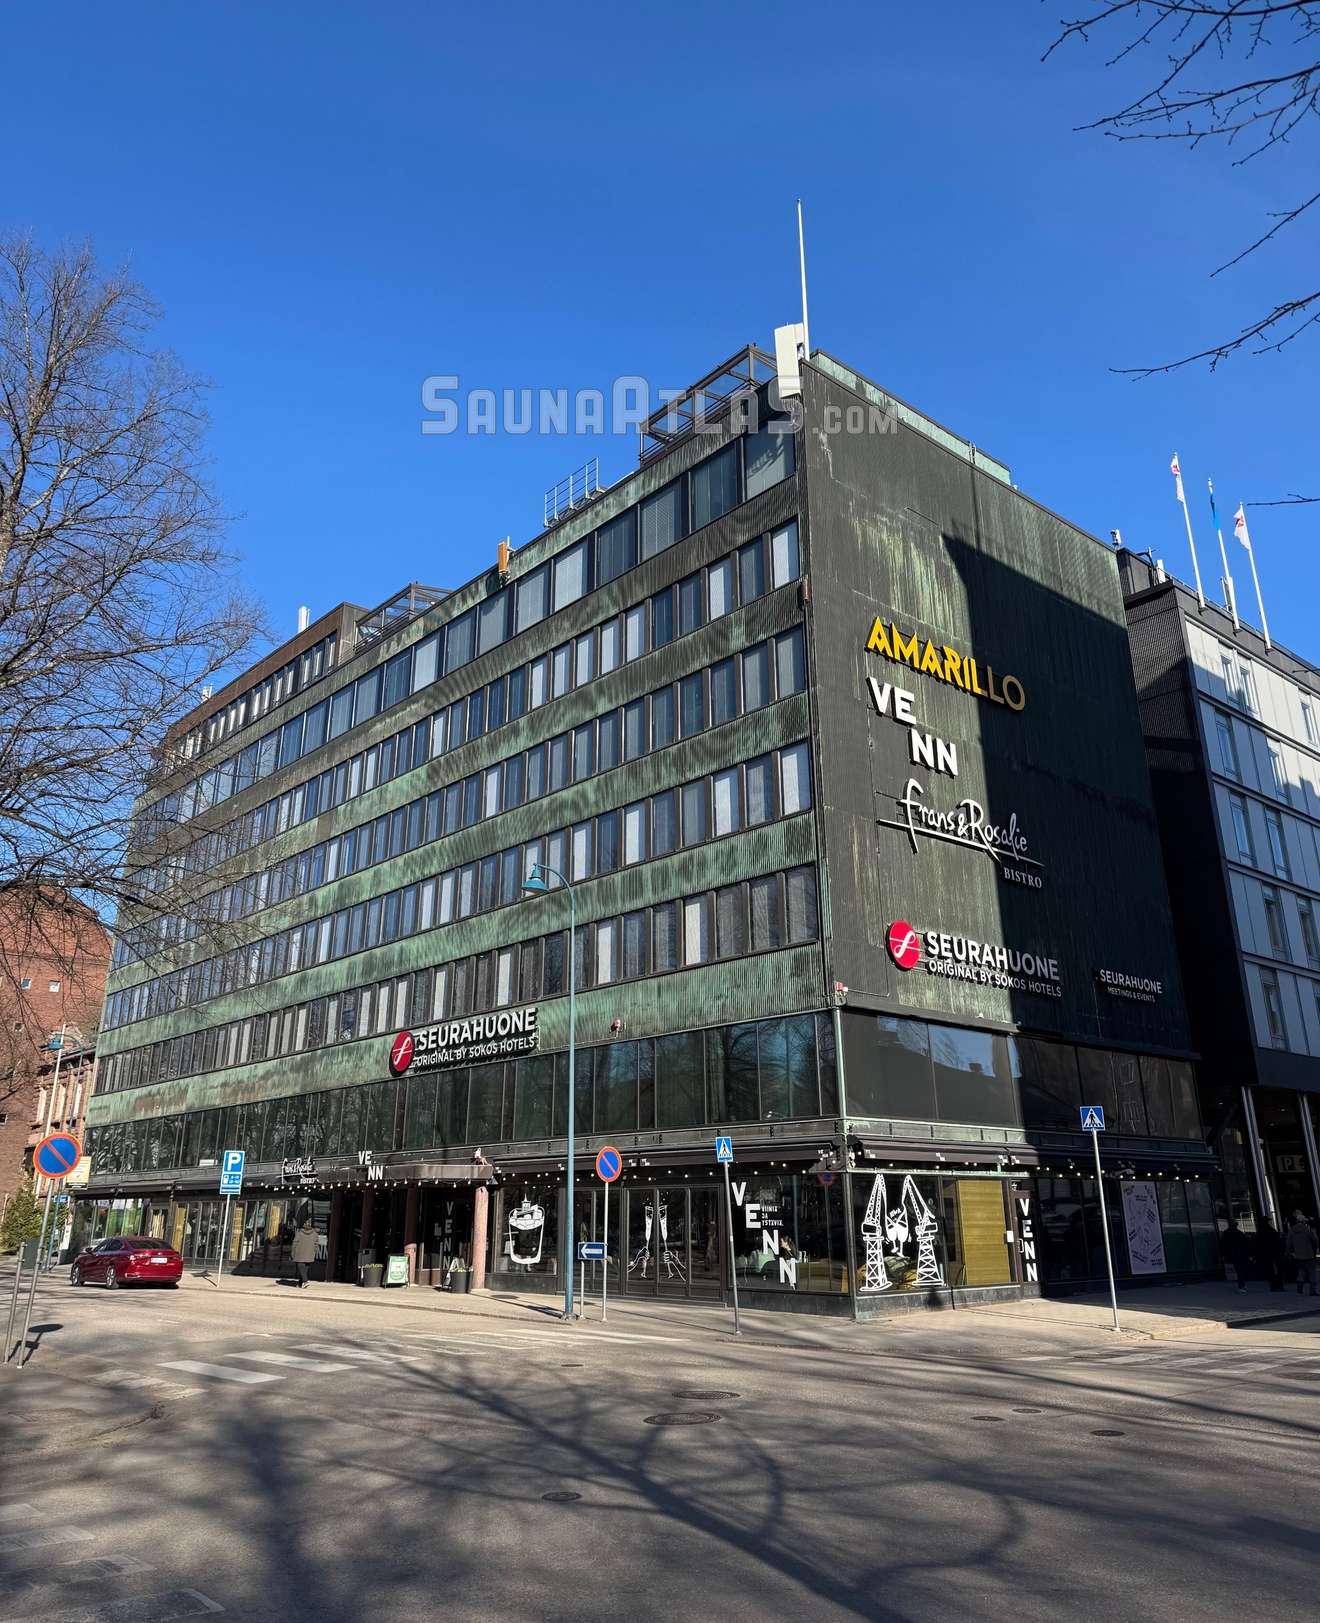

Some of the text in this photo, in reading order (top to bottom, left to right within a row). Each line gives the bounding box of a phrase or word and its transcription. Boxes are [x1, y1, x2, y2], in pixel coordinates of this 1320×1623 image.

[867, 616, 1026, 711] AMARILLO
[868, 677, 917, 725] VE
[911, 728, 959, 777] NN
[1003, 866, 1043, 889] BISTRO
[926, 931, 1061, 981] SEURAHUONE
[928, 959, 1062, 998] ORIGINAL BY SOKOS HOTELS
[1100, 969, 1163, 994] SEURAHUONE
[418, 1008, 537, 1051] SEURAHUONE
[417, 1036, 535, 1067] ORIGINAL BY SOKOS HOTELS
[227, 1152, 242, 1171] P
[367, 1165, 384, 1180] NN
